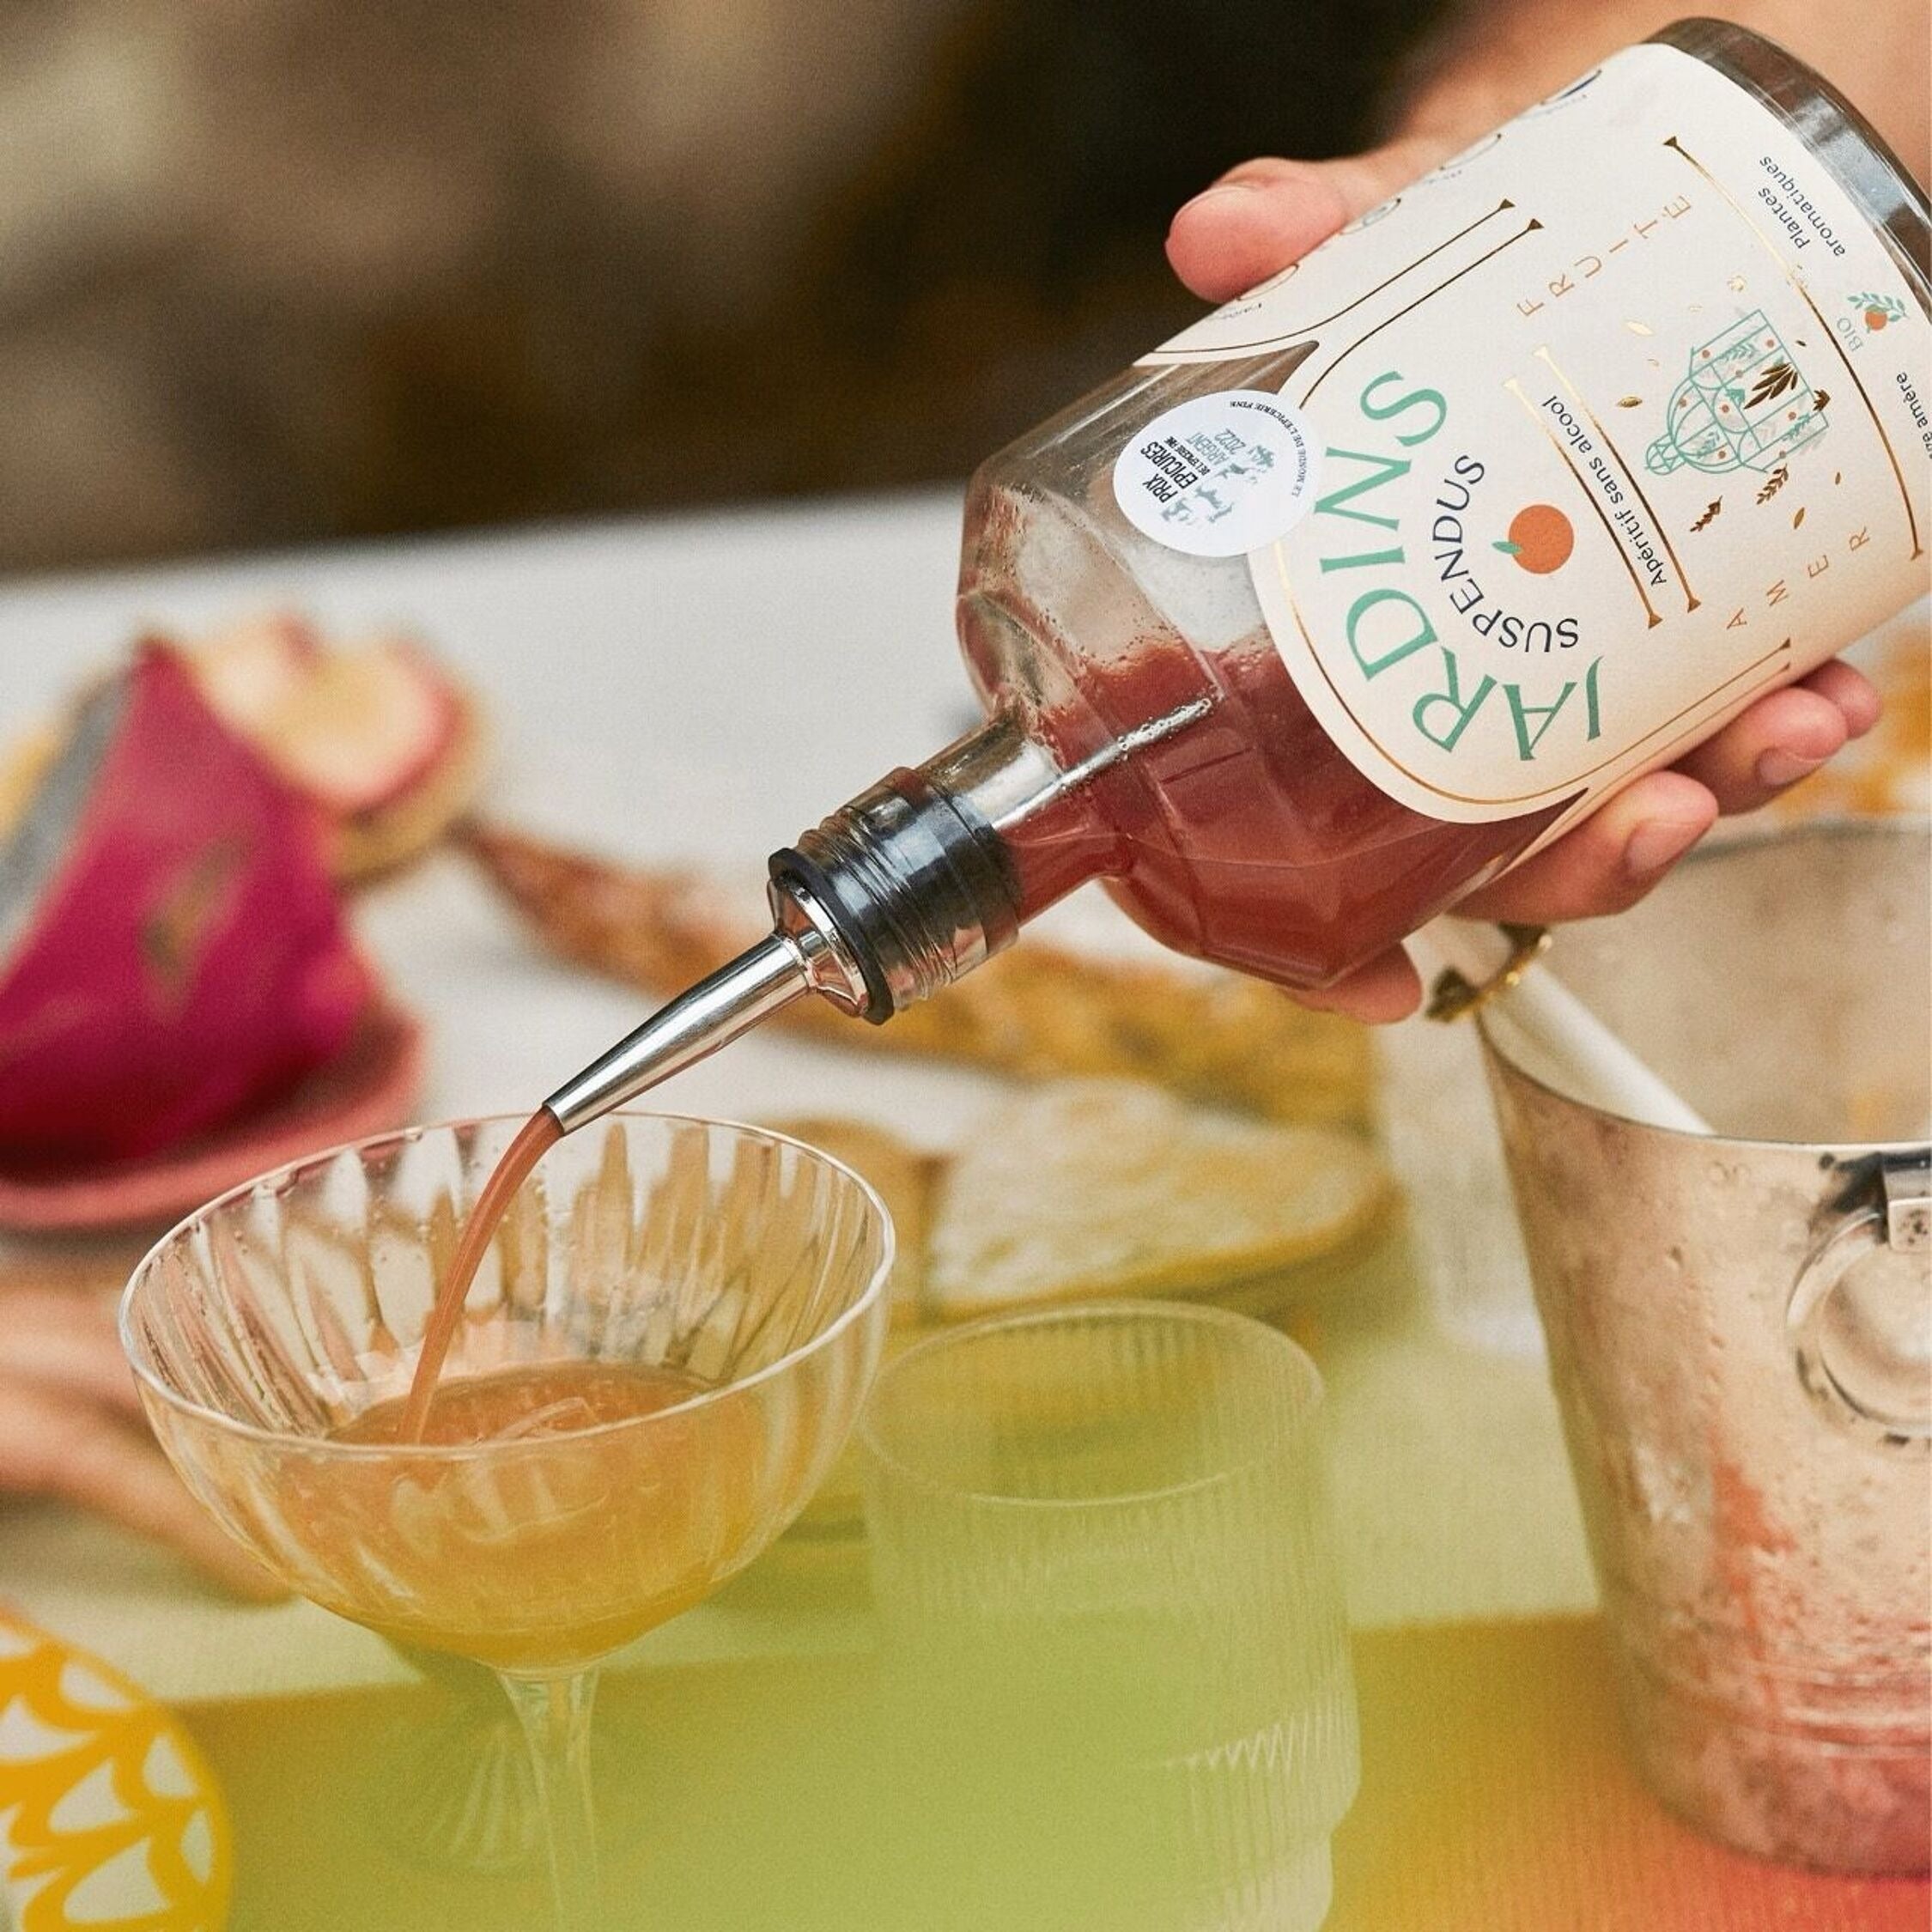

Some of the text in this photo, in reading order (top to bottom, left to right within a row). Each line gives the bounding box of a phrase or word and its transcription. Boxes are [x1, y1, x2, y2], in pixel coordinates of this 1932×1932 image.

[1758, 187, 1810, 249] Plantes
[1759, 155, 1845, 257] aromatiques
[1836, 317, 1863, 352] BIO
[1896, 371, 1929, 428] amère
[1140, 441, 1199, 489] EPICURES
[1186, 432, 1230, 465] ARGENT
[1214, 428, 1247, 455] 2022
[1142, 473, 1178, 503] PRIX
[1540, 395, 1668, 587] Apéritif sans alcool
[1314, 370, 1604, 762] JARDINS
[1432, 455, 1579, 653] SUSPENDUS
[1726, 526, 1870, 629] AMER
